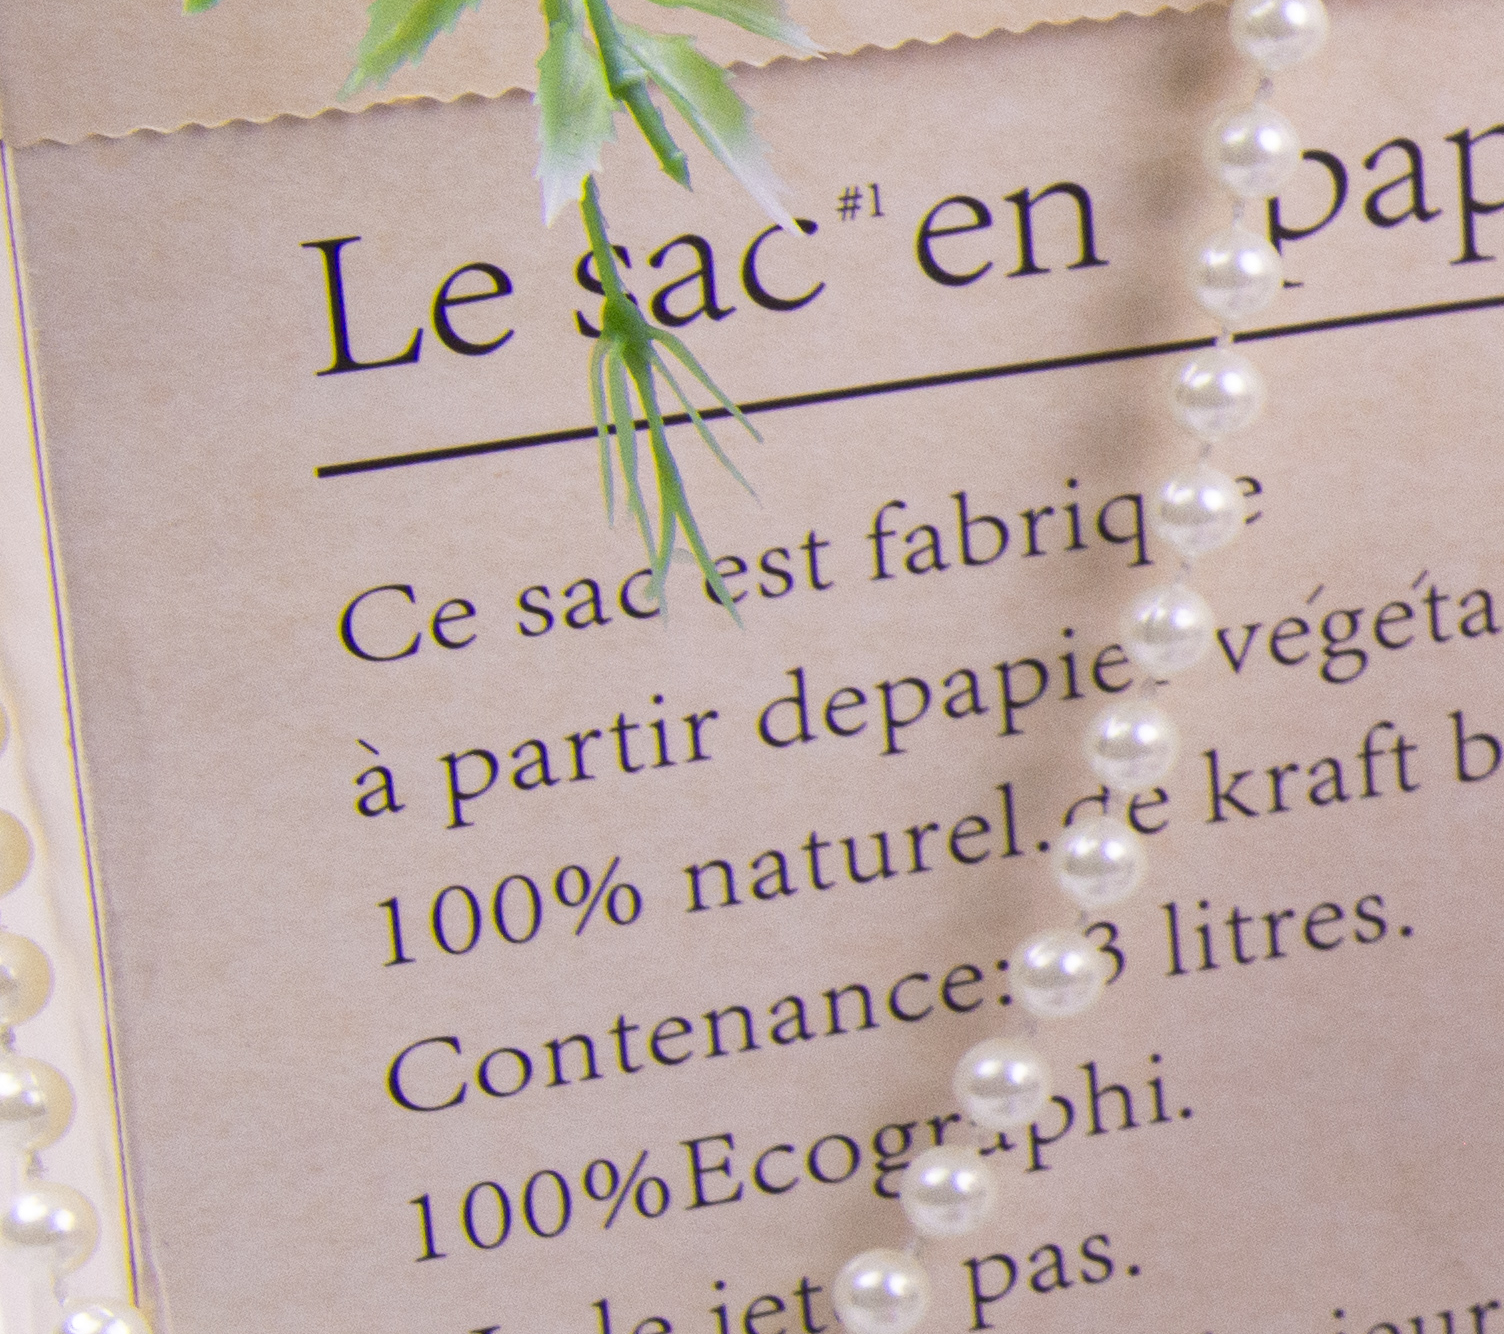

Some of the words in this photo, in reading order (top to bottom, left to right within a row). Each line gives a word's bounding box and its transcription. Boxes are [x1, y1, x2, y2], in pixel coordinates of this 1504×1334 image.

[301, 235, 515, 377] Le
[572, 217, 826, 339] sac
[836, 183, 886, 223] #1
[914, 176, 1110, 288] en
[337, 583, 478, 662] Ce
[516, 567, 662, 638] sac
[703, 528, 835, 606] est
[866, 475, 1263, 581] fabriqe
[352, 738, 406, 818] à
[438, 693, 720, 830] partir
[756, 627, 1169, 758] depapie
[375, 856, 643, 968] 100%
[1201, 719, 1420, 825] kraft
[384, 957, 1012, 1113] Contenance:
[1159, 892, 1414, 977] litres.
[960, 1232, 1143, 1332] pas.
